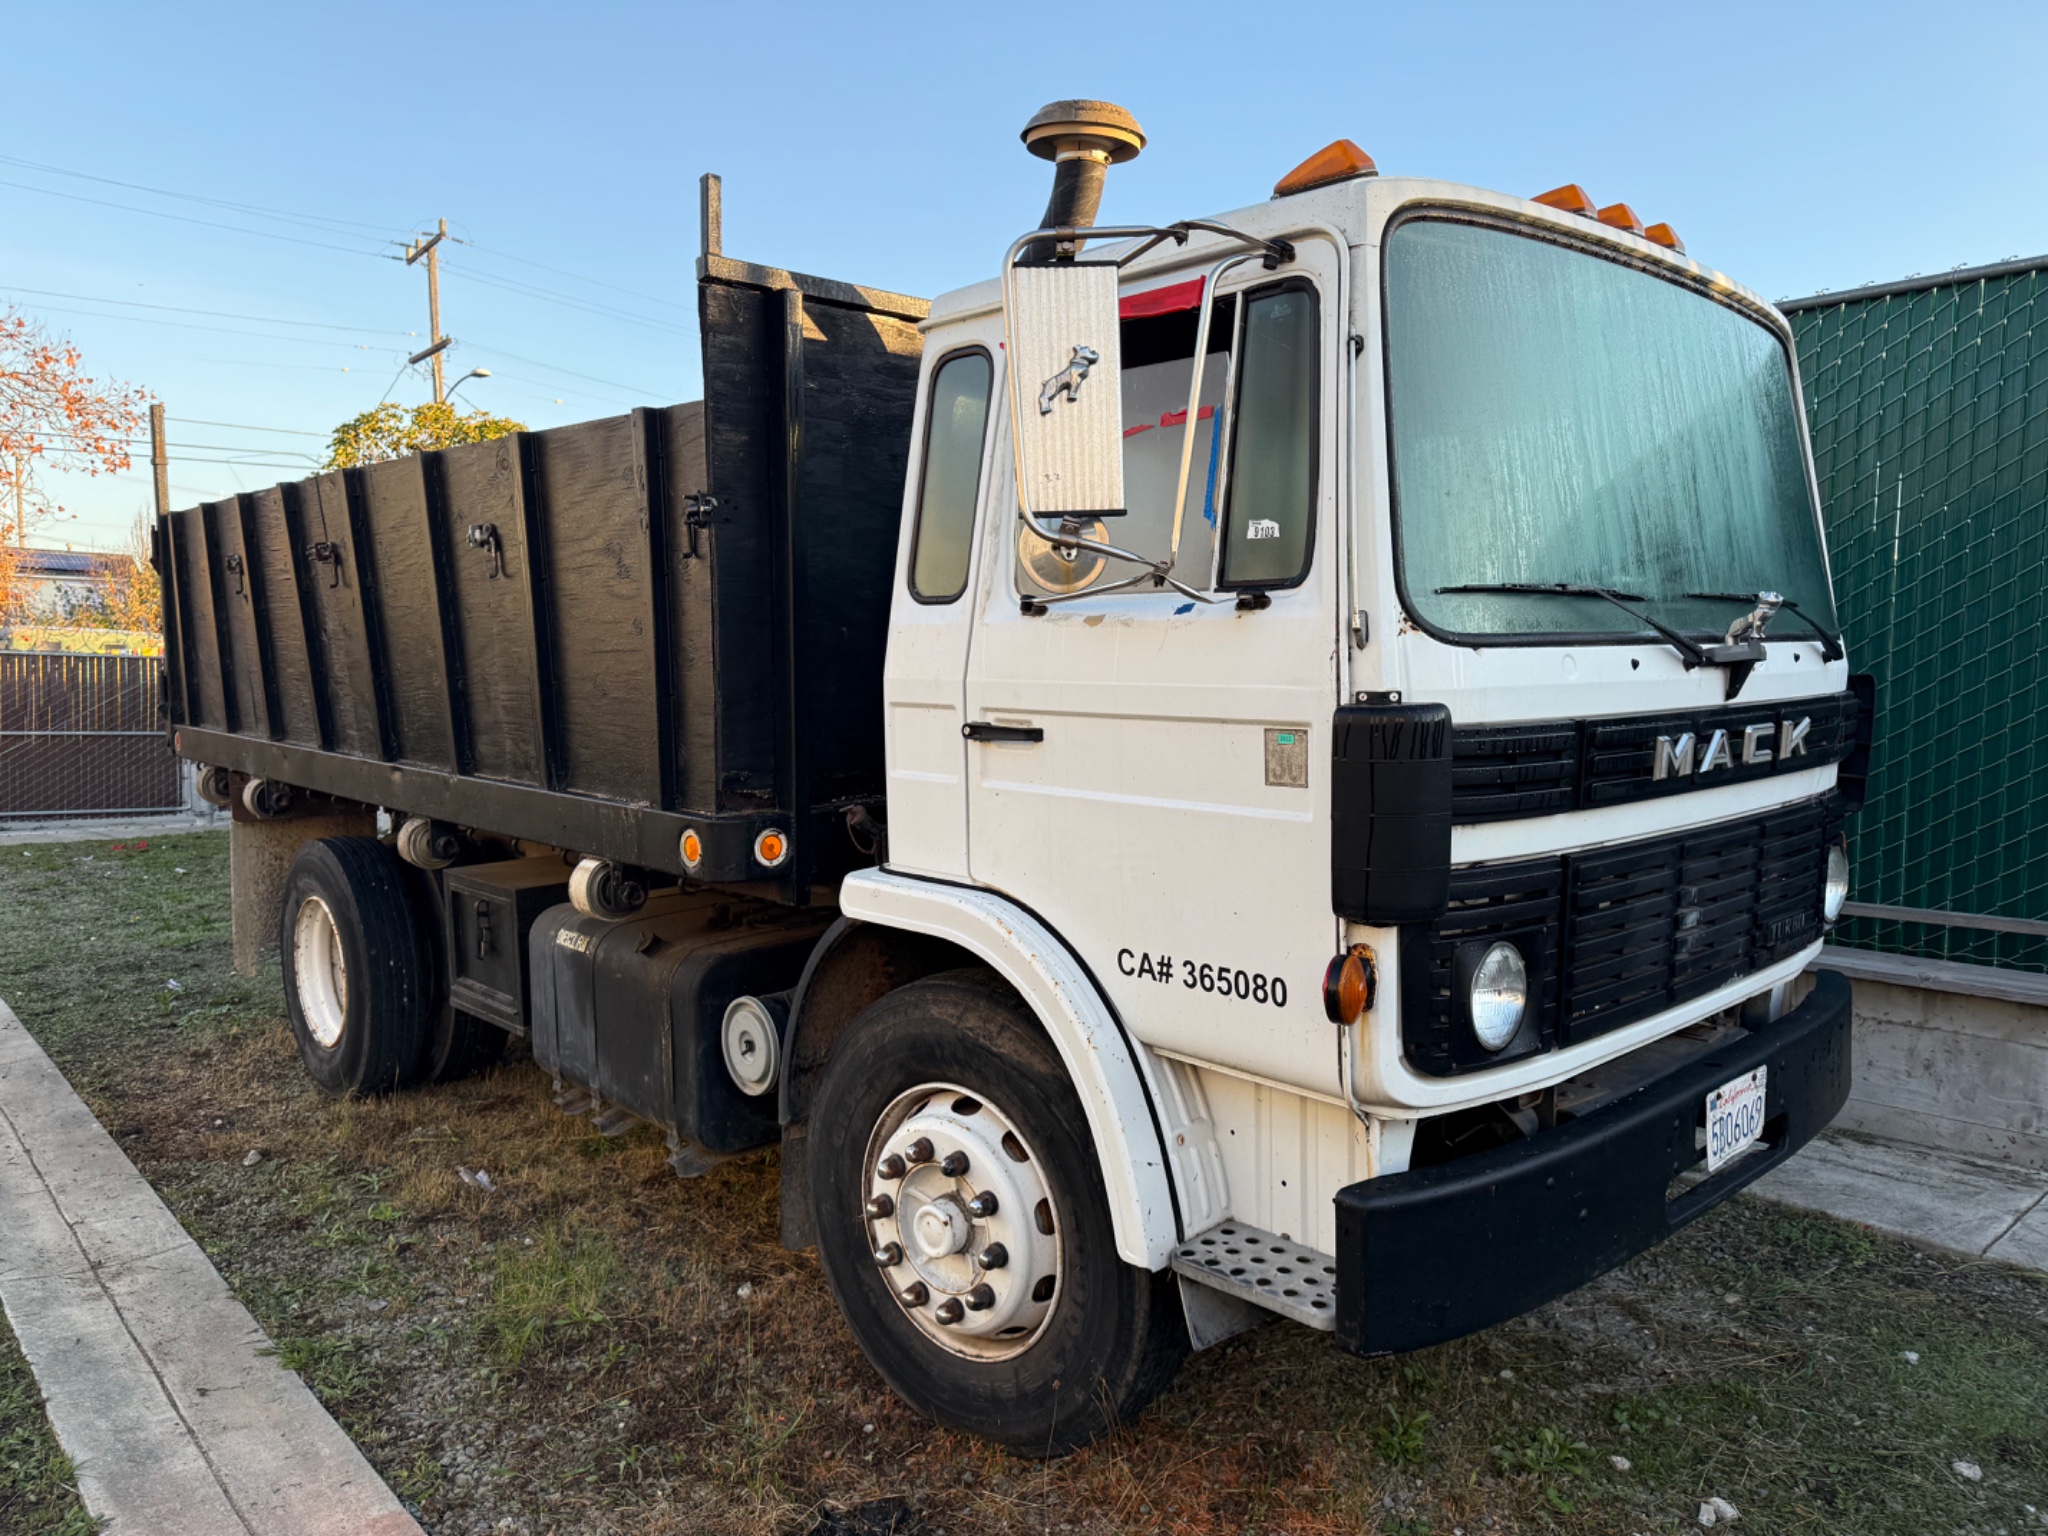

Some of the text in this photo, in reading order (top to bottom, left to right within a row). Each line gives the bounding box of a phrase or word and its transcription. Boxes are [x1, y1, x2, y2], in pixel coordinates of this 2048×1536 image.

[1652, 716, 1811, 781] MACK
[1117, 948, 1288, 1007] CA# 365080
